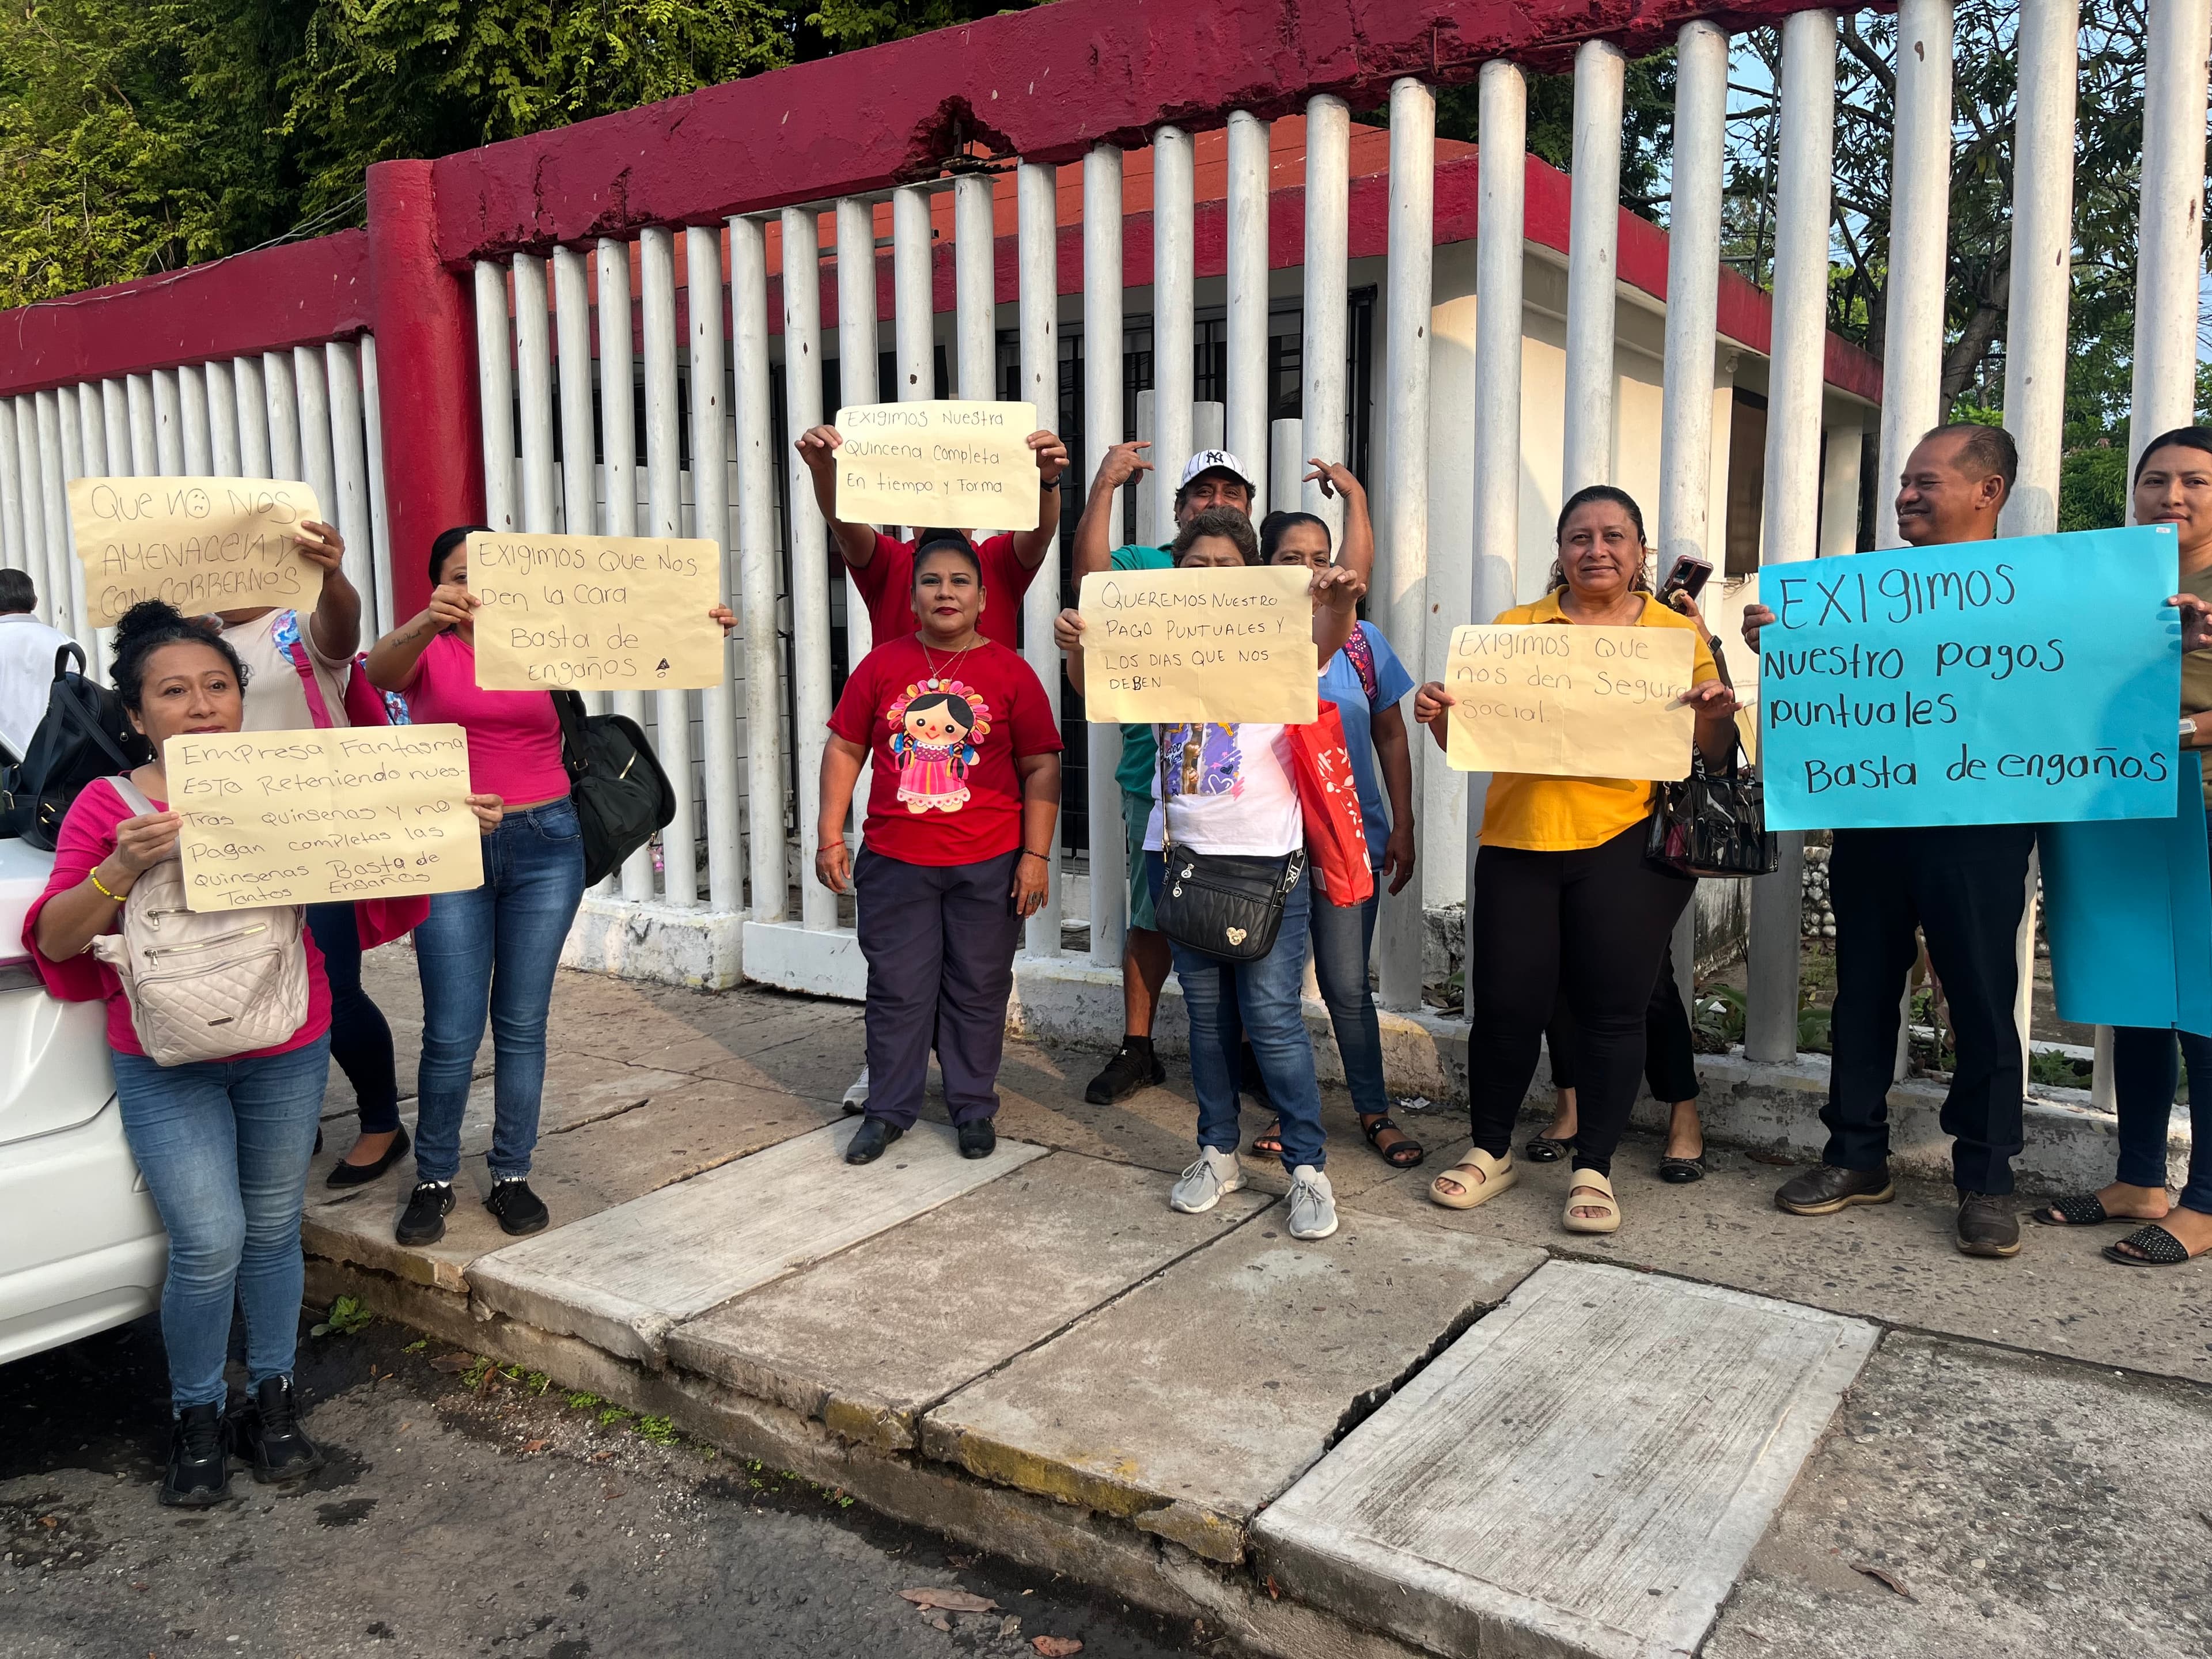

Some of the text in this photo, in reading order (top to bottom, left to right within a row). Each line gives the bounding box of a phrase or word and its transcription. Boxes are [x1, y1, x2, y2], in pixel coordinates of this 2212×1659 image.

[943, 410, 1003, 426] Nuestra
[845, 440, 999, 464] Quincena Completa
[847, 473, 865, 489] En
[877, 472, 933, 494] tiempo
[228, 490, 297, 524] NOS
[658, 544, 697, 576] Nos
[482, 589, 528, 611] Den
[574, 584, 626, 604] Cara
[1102, 581, 1206, 611] QUEREMOS
[512, 623, 639, 649] Basta de
[1107, 620, 1152, 637] PAGO
[1167, 620, 1265, 641] PUNTUALES
[1105, 650, 1268, 670] LOS DIAS QUE NOS
[1937, 639, 2065, 680] pagos
[1109, 676, 1161, 691] DEBEN
[1528, 665, 1571, 689] den
[1769, 691, 1956, 729] puntuales
[181, 736, 464, 764] Empresa Fantasma
[1805, 743, 2166, 793] Basta de engaños
[187, 843, 266, 863] Pagan
[404, 827, 444, 840] las
[325, 855, 405, 880] Basta
[416, 851, 440, 865] de
[217, 887, 292, 906] Tantos
